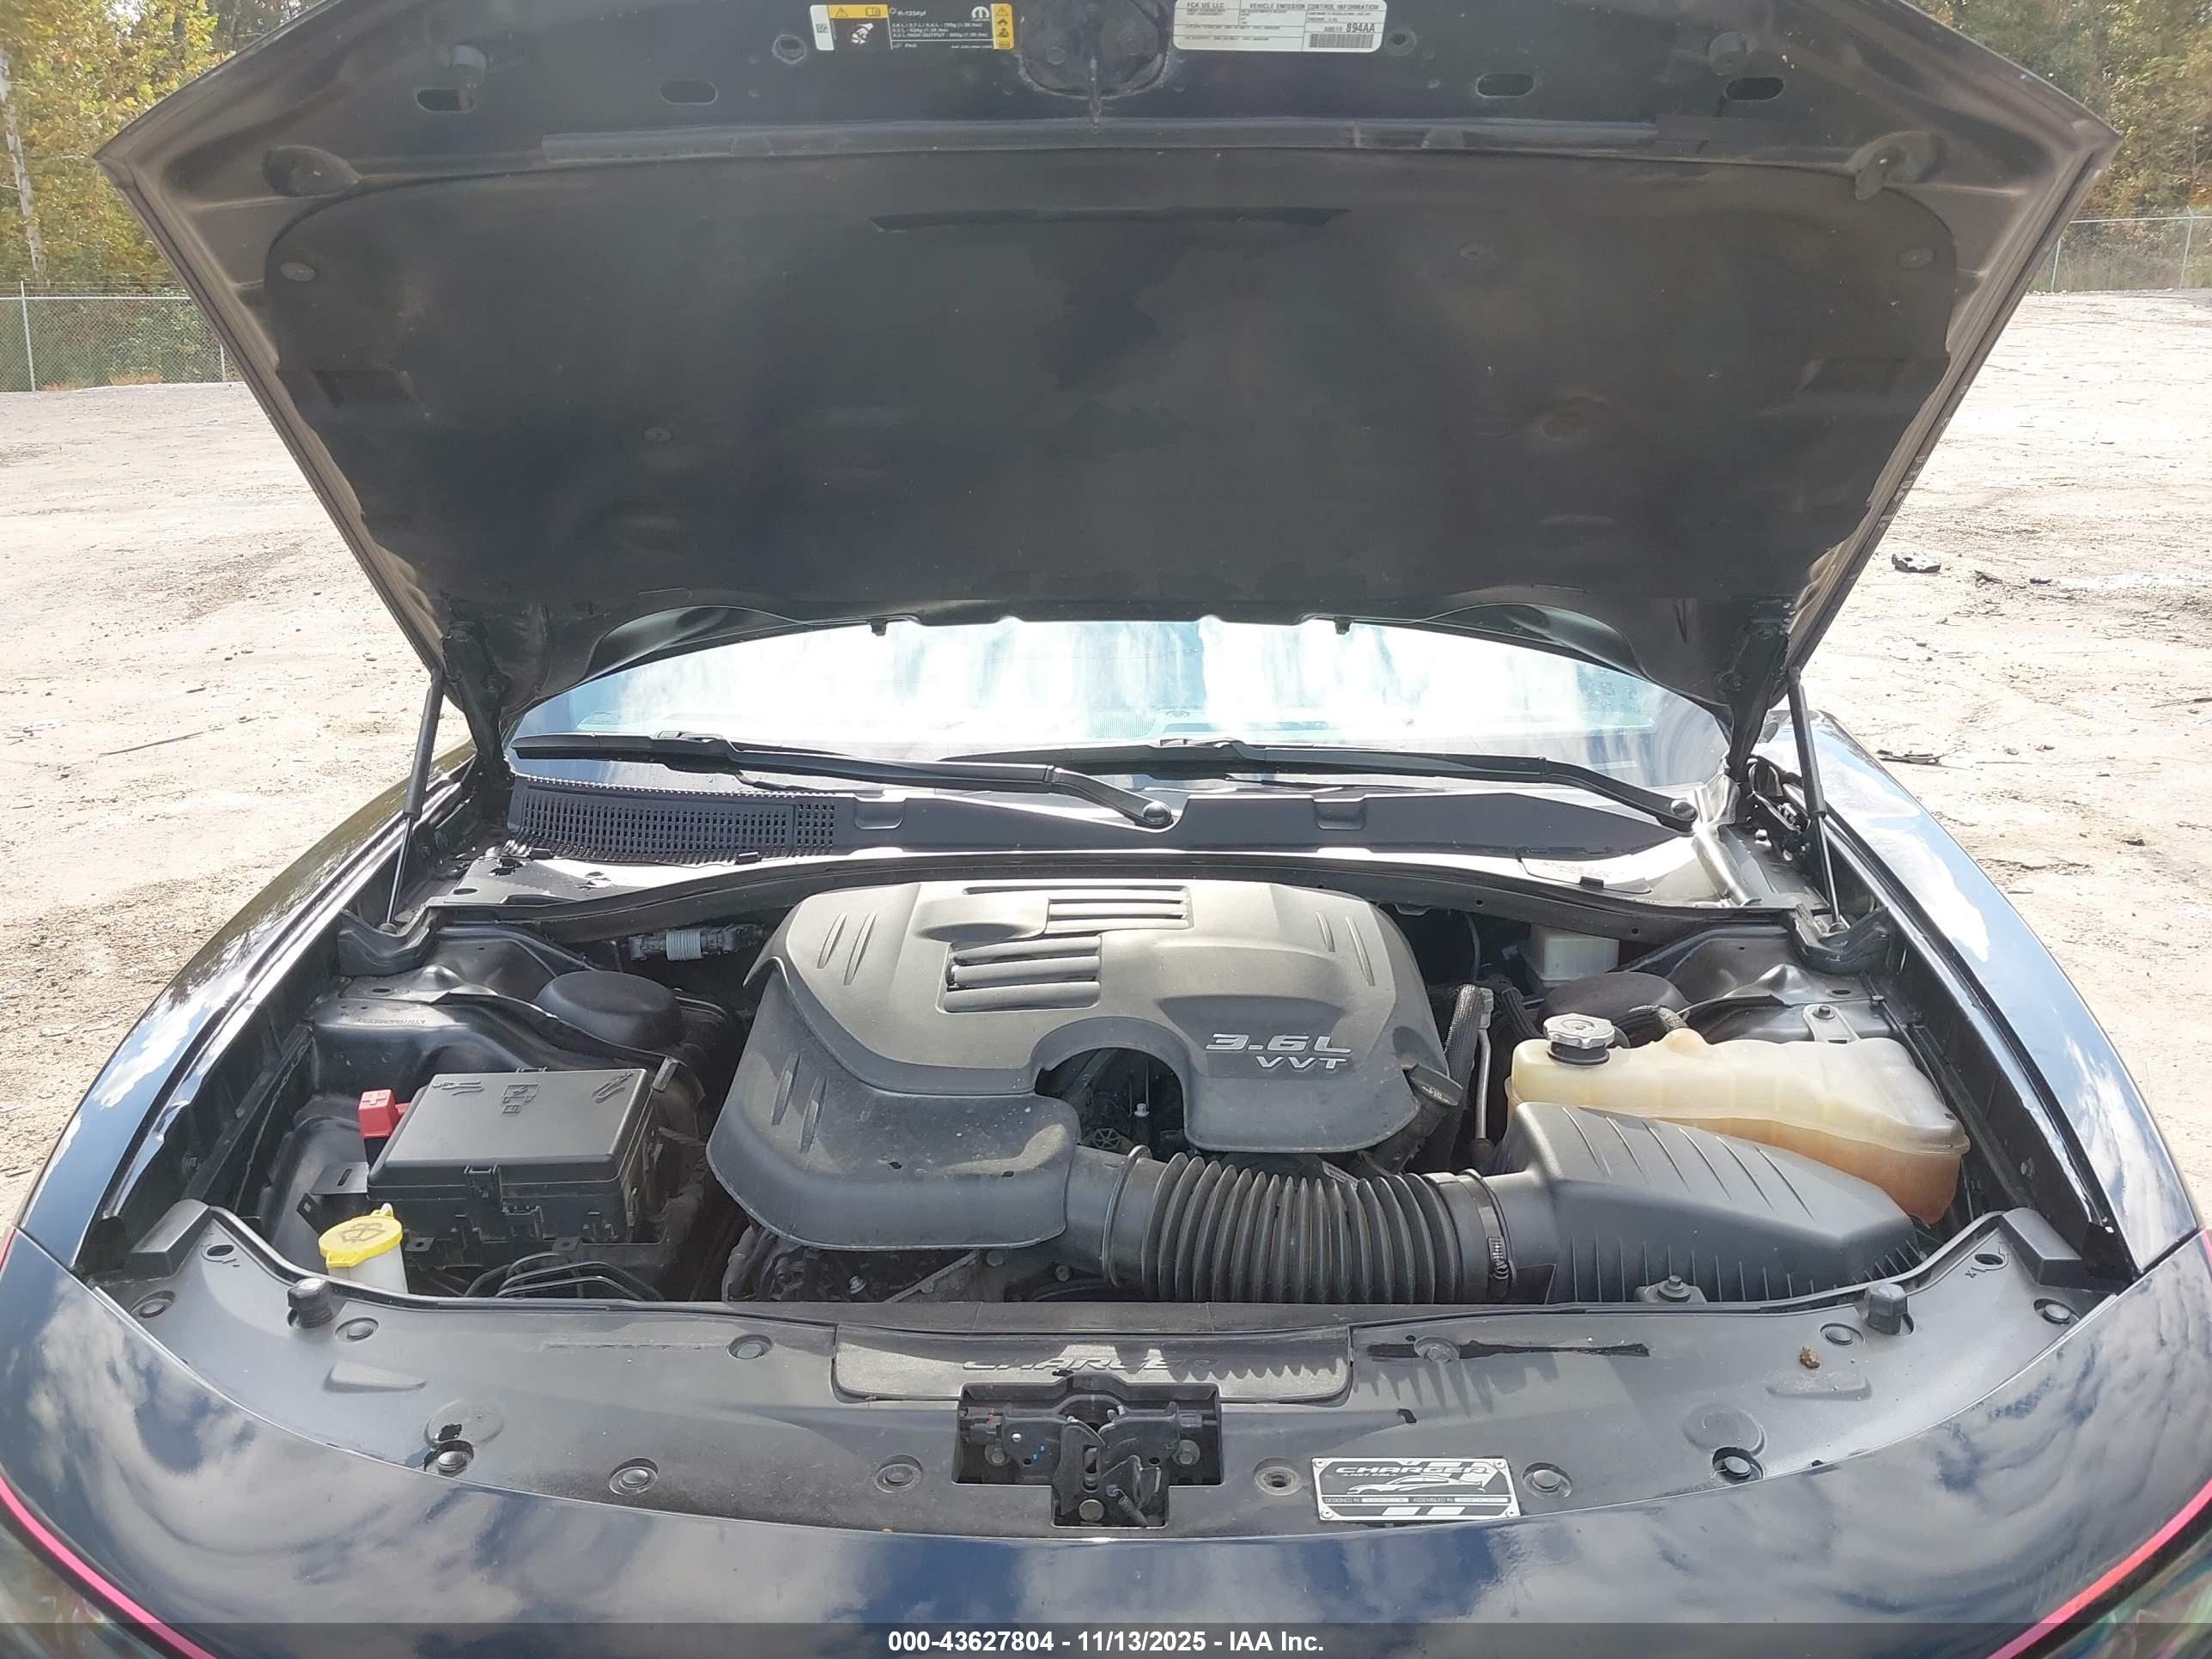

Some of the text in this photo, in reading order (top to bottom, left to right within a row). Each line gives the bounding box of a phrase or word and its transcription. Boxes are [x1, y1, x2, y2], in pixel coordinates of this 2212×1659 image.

[1346, 22, 1375, 33] 894AA
[1205, 1033, 1352, 1054] 3.6L
[1255, 1055, 1347, 1070] VVT
[1335, 1466, 1491, 1475] CHARGER
